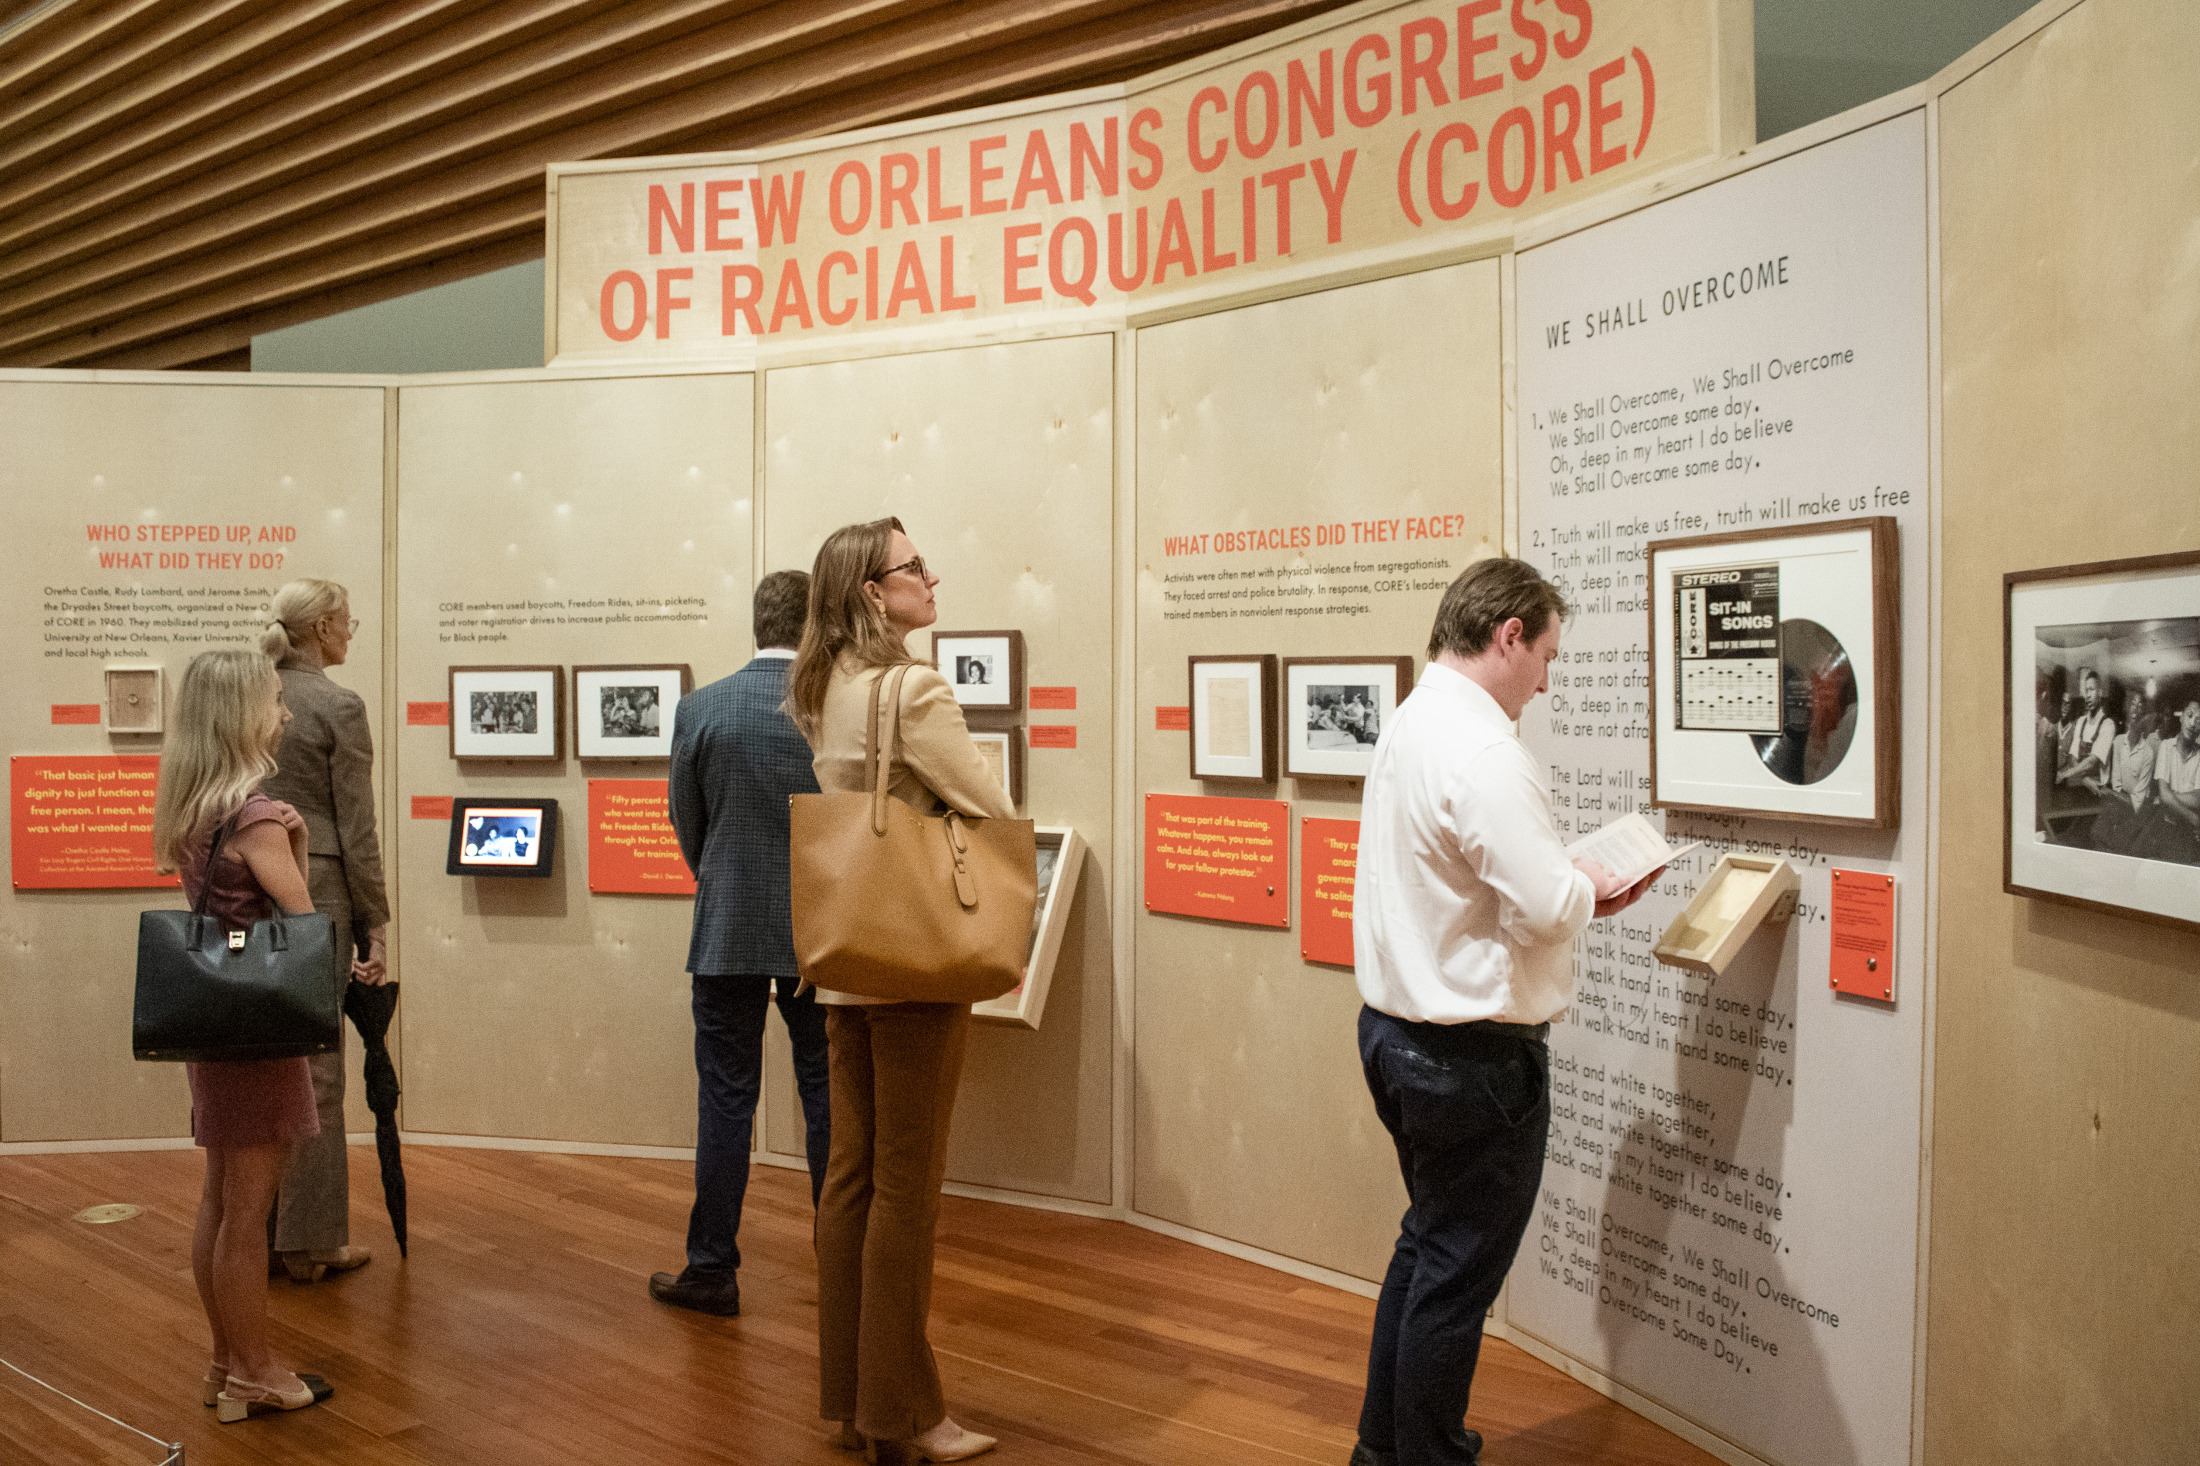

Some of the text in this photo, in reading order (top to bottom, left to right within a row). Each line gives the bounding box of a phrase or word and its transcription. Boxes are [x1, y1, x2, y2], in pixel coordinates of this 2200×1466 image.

[647, 0, 1593, 256] NEW ORLEANS CONGRESS
[599, 46, 1656, 342] OF RACIAL EQUALITY (CORE)
[1546, 256, 1790, 350] WE SHALL OVERCOME
[1532, 349, 1854, 430] 1. We Shall Overcome, We Shall Overcome
[1550, 395, 1760, 450] We Shall Overcome some day.
[1551, 456, 1574, 474] Oh,
[1580, 451, 1610, 470] deep
[1616, 446, 1627, 462] in
[1634, 446, 1650, 463] my
[1658, 434, 1693, 454] heart
[1710, 425, 1728, 446] do
[1734, 419, 1793, 441] believe
[1551, 450, 1760, 497] We Shall Overcome some day.
[1533, 486, 1910, 547] 2. Truth will make us free, truth will make us free
[86, 525, 296, 545] WHO STEPPED UP, AND
[1164, 514, 1465, 557] WHAT OBSTACLES DID THEY FACE?
[100, 552, 284, 570] WHAT DID THEY DO?
[1165, 573, 1194, 583] Activists
[1218, 569, 1238, 580] often
[1241, 570, 1255, 579] met
[1258, 567, 1274, 577] with
[1277, 565, 1312, 579] physical
[1315, 564, 1350, 574] violence
[1354, 562, 1374, 572] from
[1378, 558, 1451, 574] segregationists.
[1682, 571, 1741, 586] STEREO
[115, 587, 137, 598] Rudy
[187, 587, 205, 596] and
[208, 588, 241, 596] Jerome
[244, 588, 270, 597] Smith,
[439, 603, 463, 612] CORE
[467, 602, 503, 610] members
[506, 601, 525, 609] used
[568, 598, 605, 608] Freedom
[608, 598, 633, 607] Rides,
[636, 598, 662, 606] sit-ins,
[665, 596, 706, 607] picketing,
[1164, 603, 1371, 619] trained members in nonviolent response strategies.
[1709, 600, 1751, 616] SIT-IN
[1721, 615, 1773, 630] SONGS
[440, 633, 451, 641] for
[454, 632, 475, 641] Black
[44, 648, 149, 659] and local high schools.
[1551, 671, 1618, 687] We are not
[68, 770, 95, 780] basic
[98, 770, 115, 781] just
[118, 770, 154, 779] human
[1551, 766, 1633, 789] The Lord will
[25, 787, 139, 800] dignity to just function
[600, 822, 612, 830] the
[1197, 817, 1213, 826] part
[1215, 816, 1222, 825] of
[1224, 816, 1235, 826] the
[1237, 818, 1270, 831] training.
[605, 835, 636, 846] through
[1158, 828, 1273, 845] Whatever happens, you remain
[634, 849, 681, 860] for training.
[1745, 837, 1826, 866] some day.
[1586, 964, 1793, 1030] walk hand in hand some day.
[1583, 1064, 1716, 1120] and white together,
[1543, 1189, 1839, 1327] We Shall Overcome, We Shall Overcome
[1673, 1319, 1750, 1374] Some Day.
